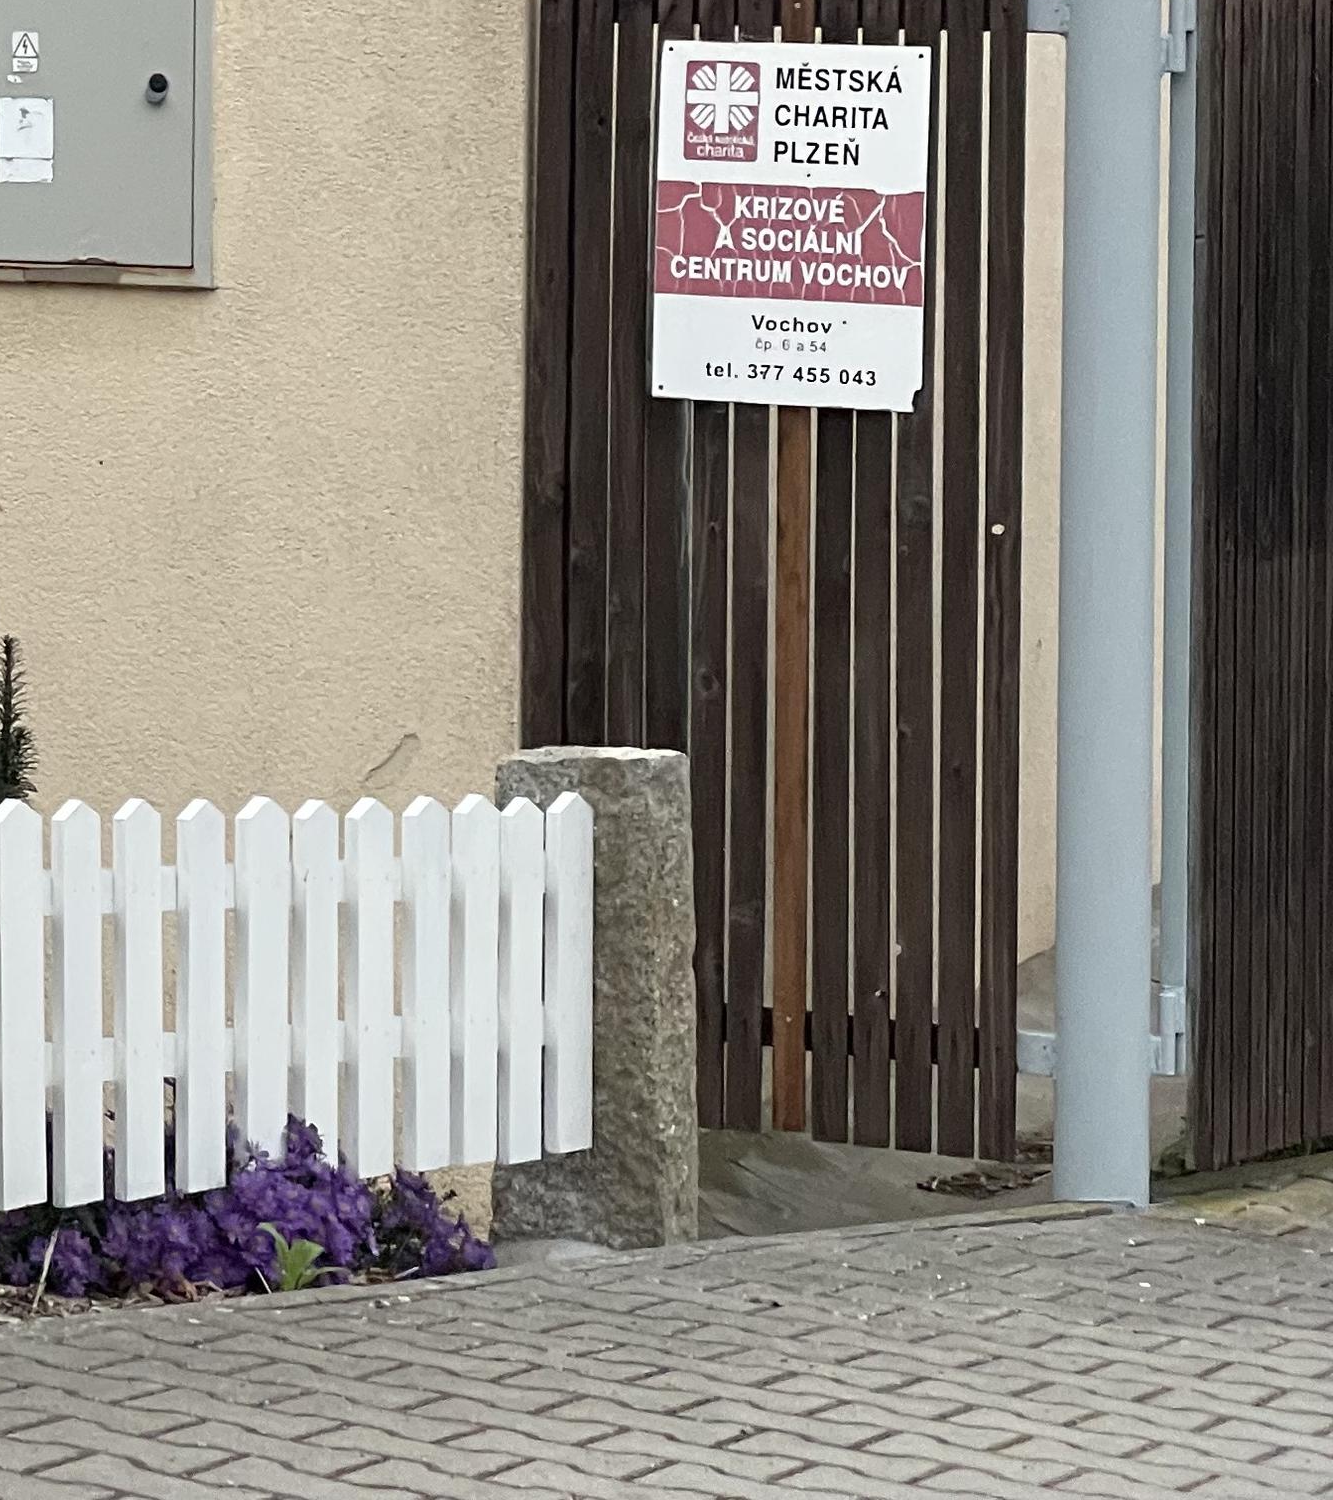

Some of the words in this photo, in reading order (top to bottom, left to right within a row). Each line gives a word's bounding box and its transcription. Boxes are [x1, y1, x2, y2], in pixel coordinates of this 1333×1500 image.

[775, 61, 902, 94] MĚSTSKÁ
[774, 104, 889, 130] CHARITA
[696, 143, 745, 158] charita
[773, 137, 860, 166] PLZEŇ
[734, 192, 844, 223] KRIZOVÉ
[714, 225, 734, 249] A
[741, 224, 862, 255] SOCIÁLNÍ
[670, 256, 792, 283] CENTRUM
[800, 261, 908, 289] VOCHOV
[751, 315, 832, 334] Vochov
[796, 342, 804, 352] a
[809, 341, 826, 352] 54
[706, 362, 739, 379] tel.
[747, 363, 784, 381] 377
[793, 366, 831, 383] 455
[839, 369, 876, 386] 043
